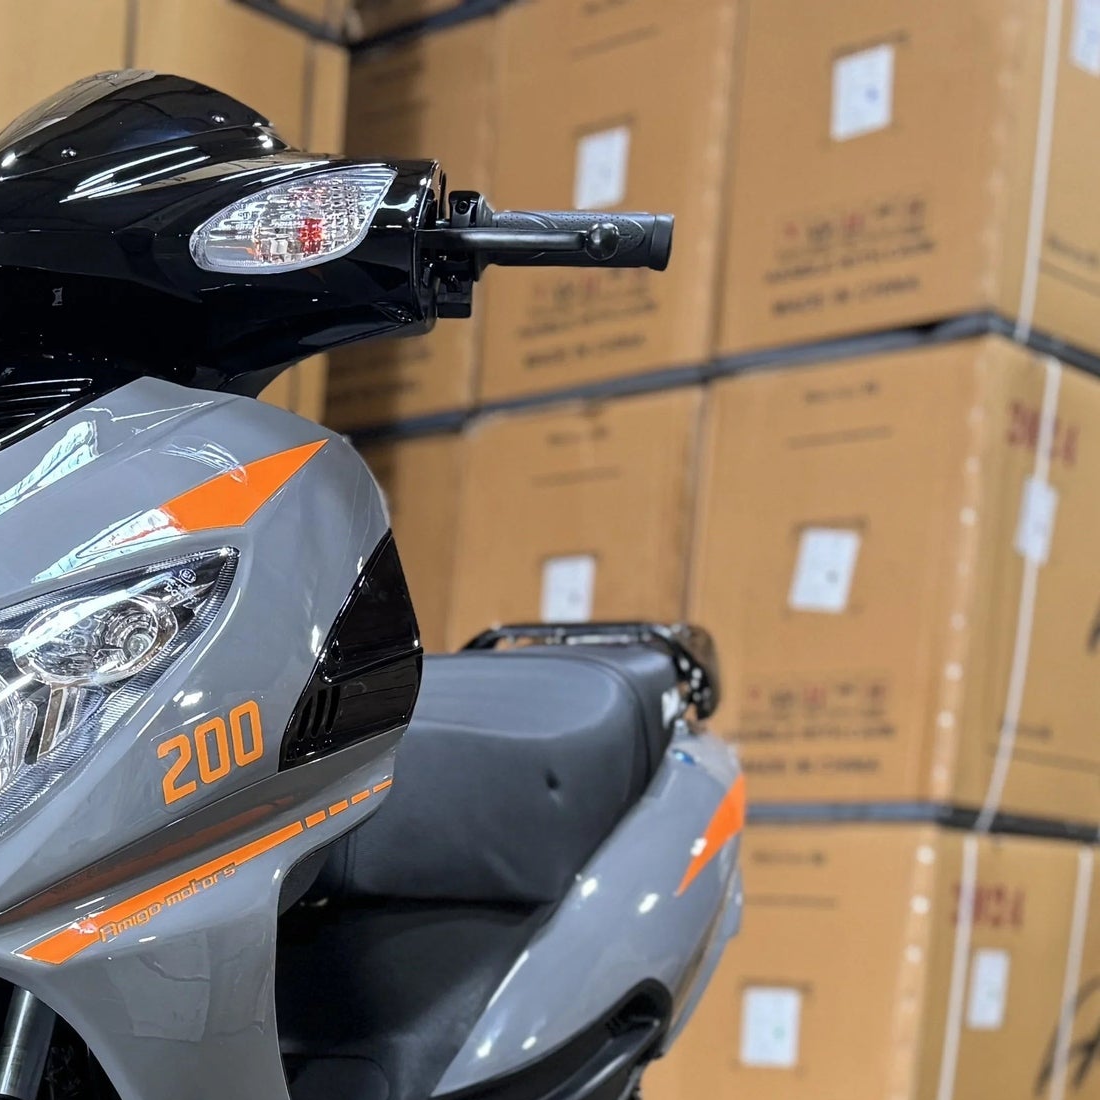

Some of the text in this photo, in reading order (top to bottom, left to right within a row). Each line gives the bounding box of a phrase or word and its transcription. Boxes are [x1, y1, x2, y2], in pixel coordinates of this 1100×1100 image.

[156, 699, 264, 806] 200
[99, 861, 237, 943] Amigo motors
